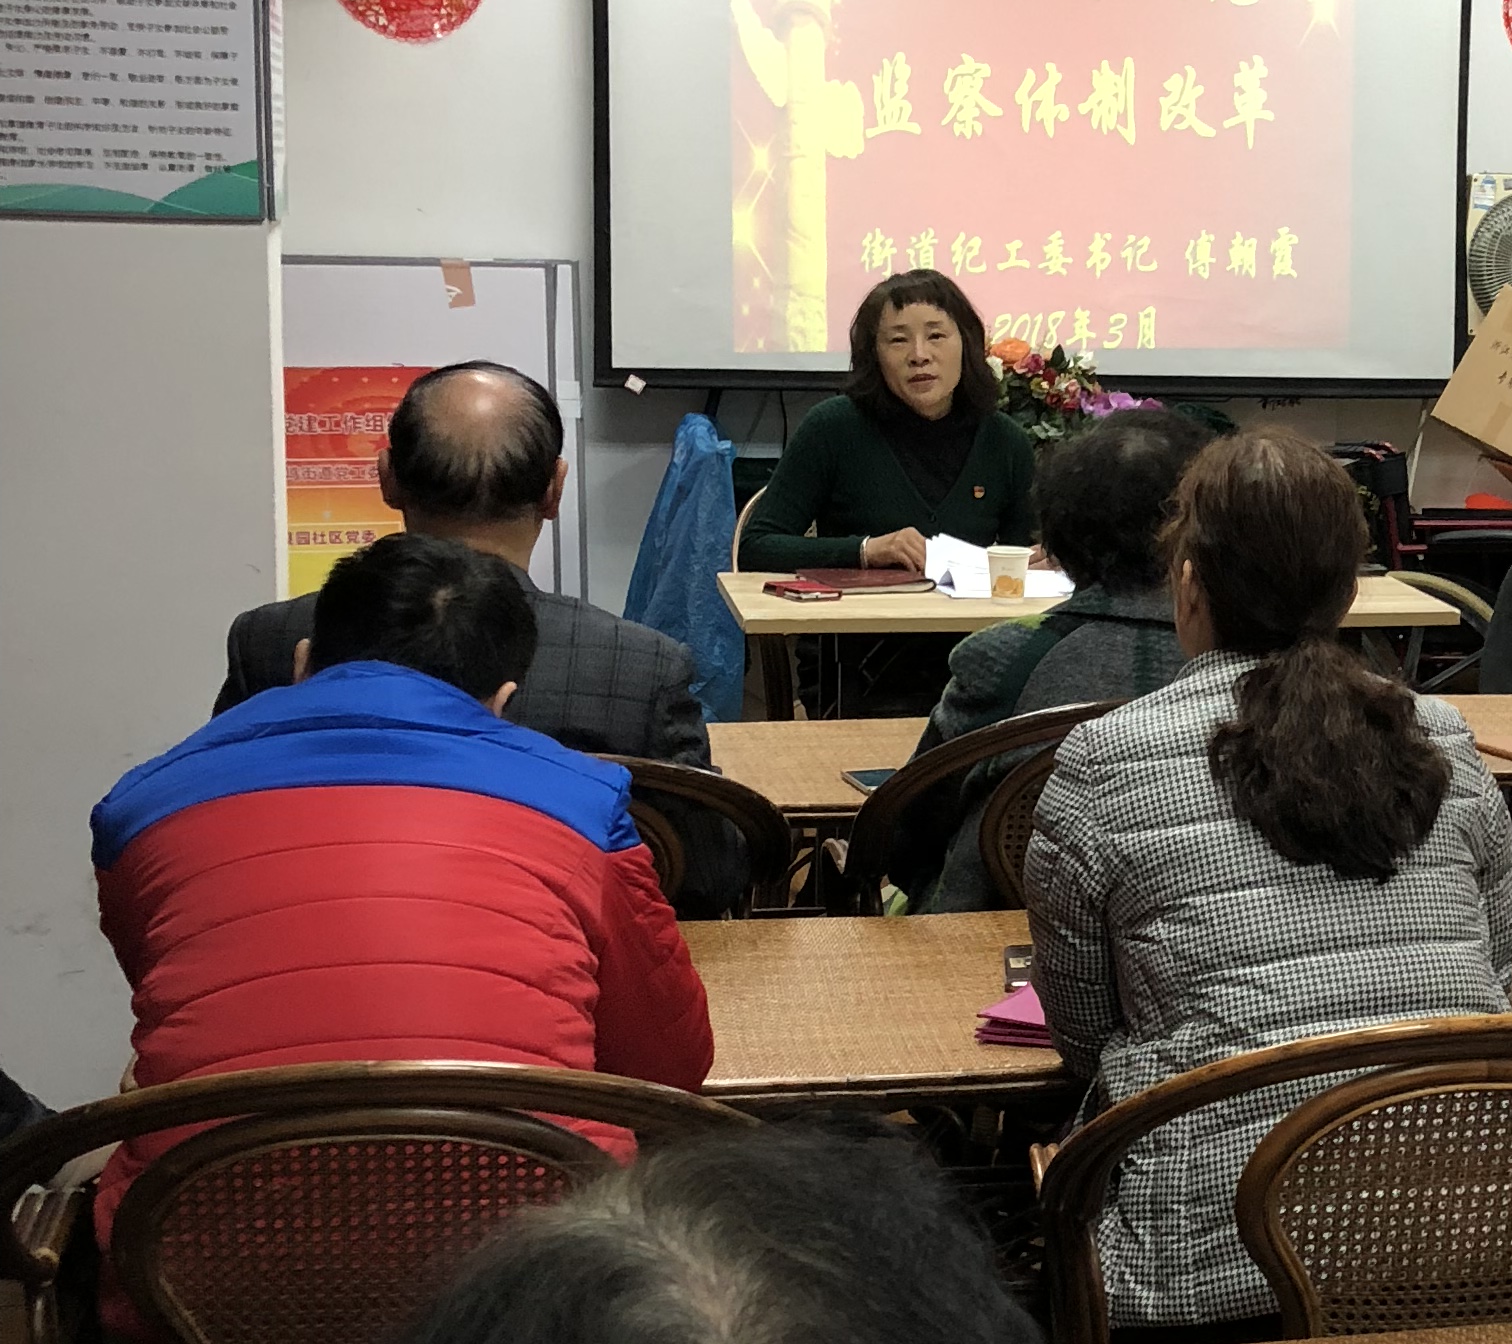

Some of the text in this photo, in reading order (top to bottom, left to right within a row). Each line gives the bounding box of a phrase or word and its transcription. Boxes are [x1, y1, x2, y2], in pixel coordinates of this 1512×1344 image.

[864, 52, 1276, 149] 监察体制改革
[859, 226, 1300, 279] 街道纪工委书记 傅朝霞
